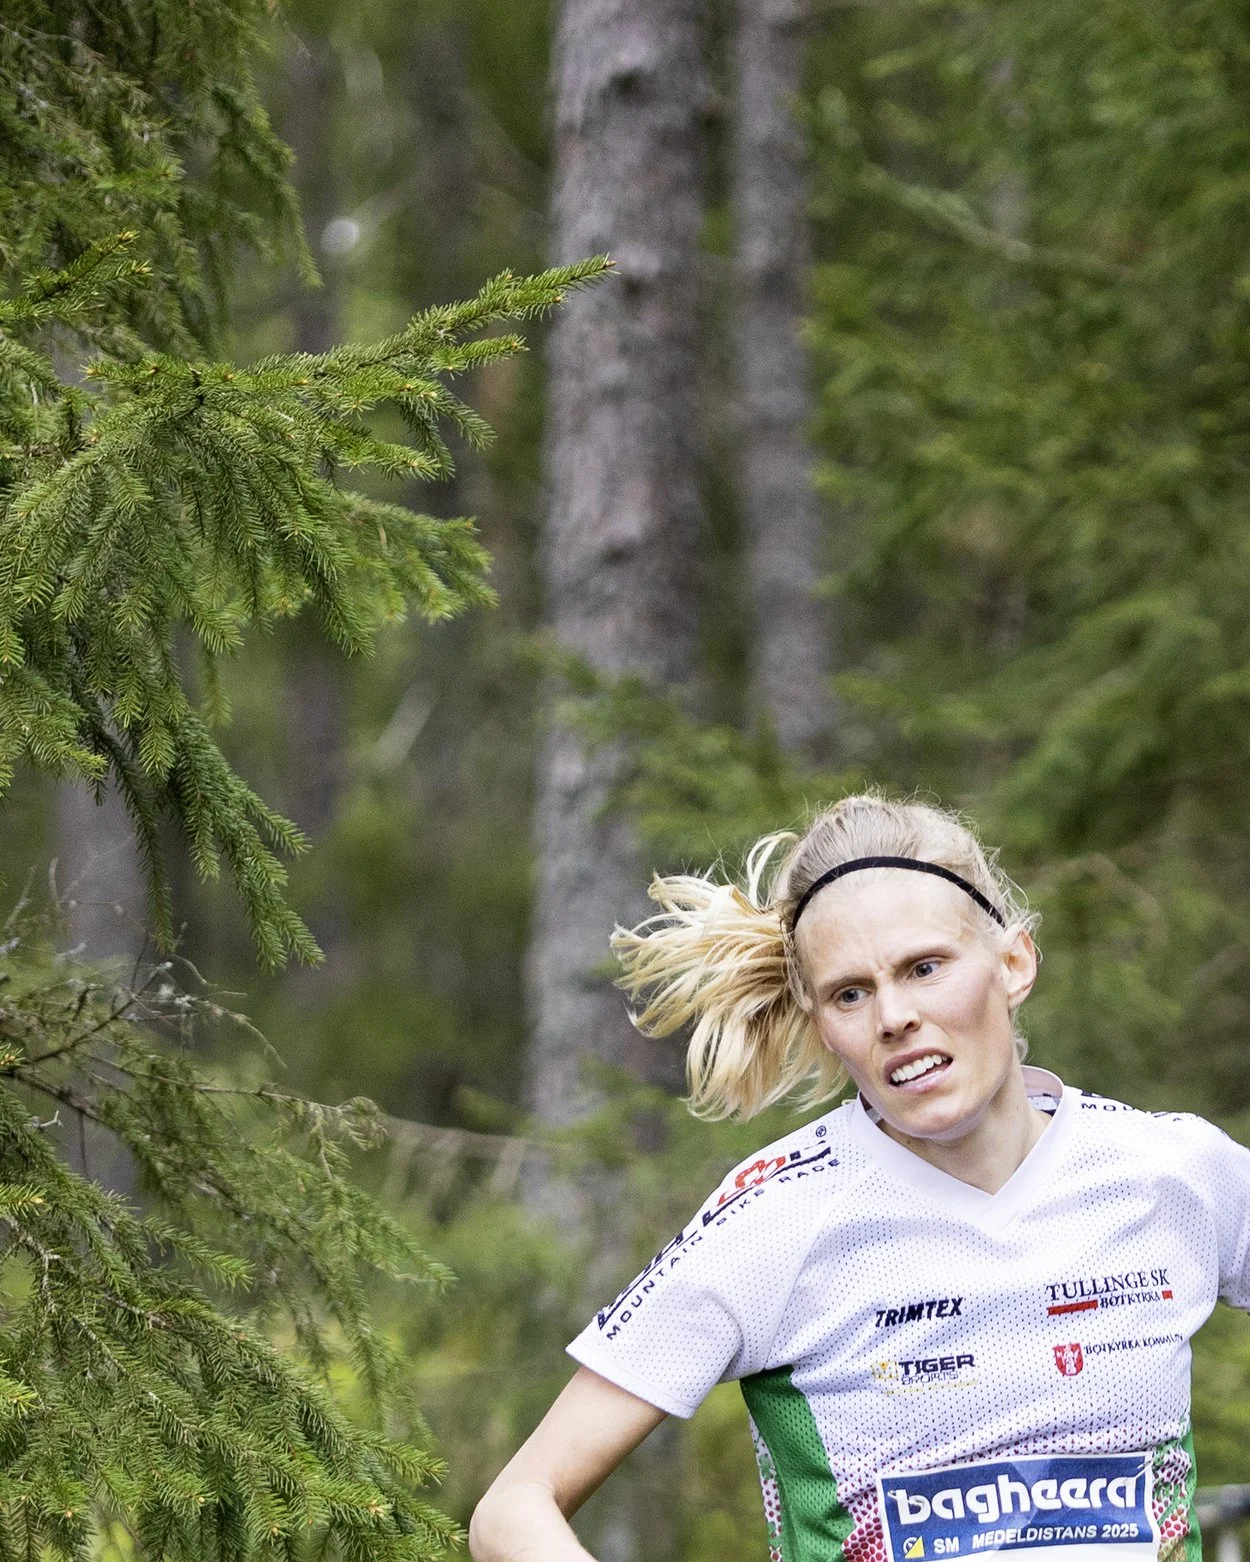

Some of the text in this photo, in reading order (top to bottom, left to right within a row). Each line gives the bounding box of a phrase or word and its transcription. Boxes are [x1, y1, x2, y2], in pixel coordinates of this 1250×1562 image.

[606, 1235, 703, 1340] MOUNTAIN
[716, 1188, 765, 1226] BIKE
[778, 1158, 840, 1183] RACE
[1045, 1268, 1170, 1301] TULLINGE SK
[1100, 1291, 1160, 1308] BOTKYRKA
[875, 1297, 963, 1327] TRIMTEX
[898, 1354, 975, 1375] TIGER
[896, 1475, 1137, 1525] bagheera
[933, 1523, 1139, 1554] SM MEDELDISTANS 2025
